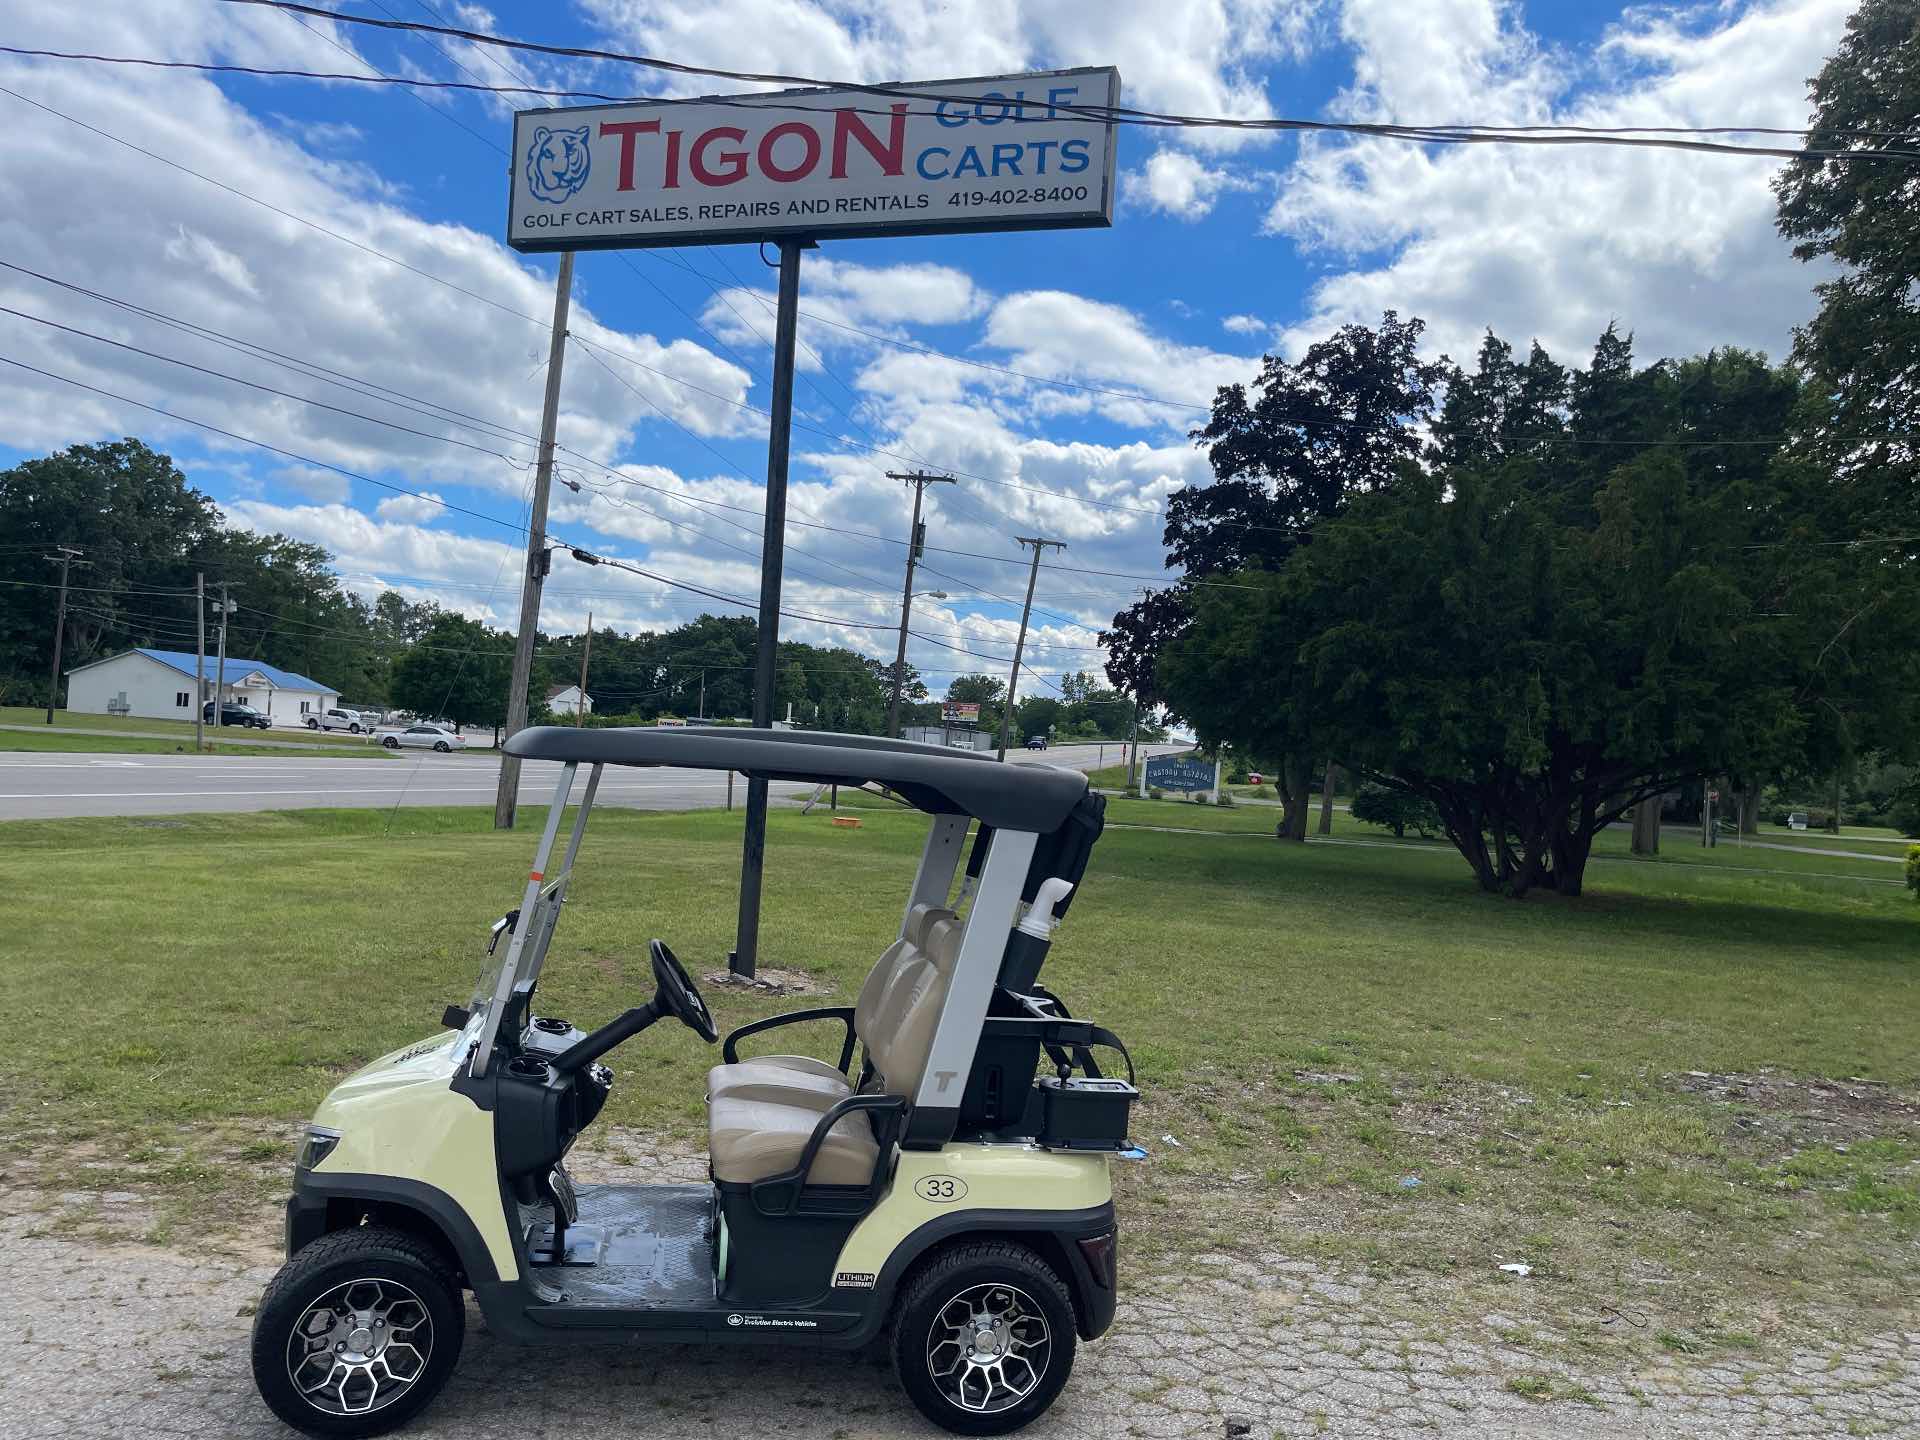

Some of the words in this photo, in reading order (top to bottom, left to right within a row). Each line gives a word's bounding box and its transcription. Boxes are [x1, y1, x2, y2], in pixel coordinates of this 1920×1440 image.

[935, 86, 1079, 129] GOLF
[600, 103, 910, 192] TIGON
[916, 139, 1090, 181] CARTS
[523, 212, 572, 229] GOLF
[575, 209, 626, 226] CART
[629, 205, 695, 224] SALES,
[698, 201, 781, 219] REPAIRS
[786, 197, 830, 216] AND
[835, 194, 930, 213] RENTALS
[947, 185, 1089, 207] 419-402-8400
[926, 1179, 955, 1198] 33
[838, 1273, 874, 1282] LITHIUM
